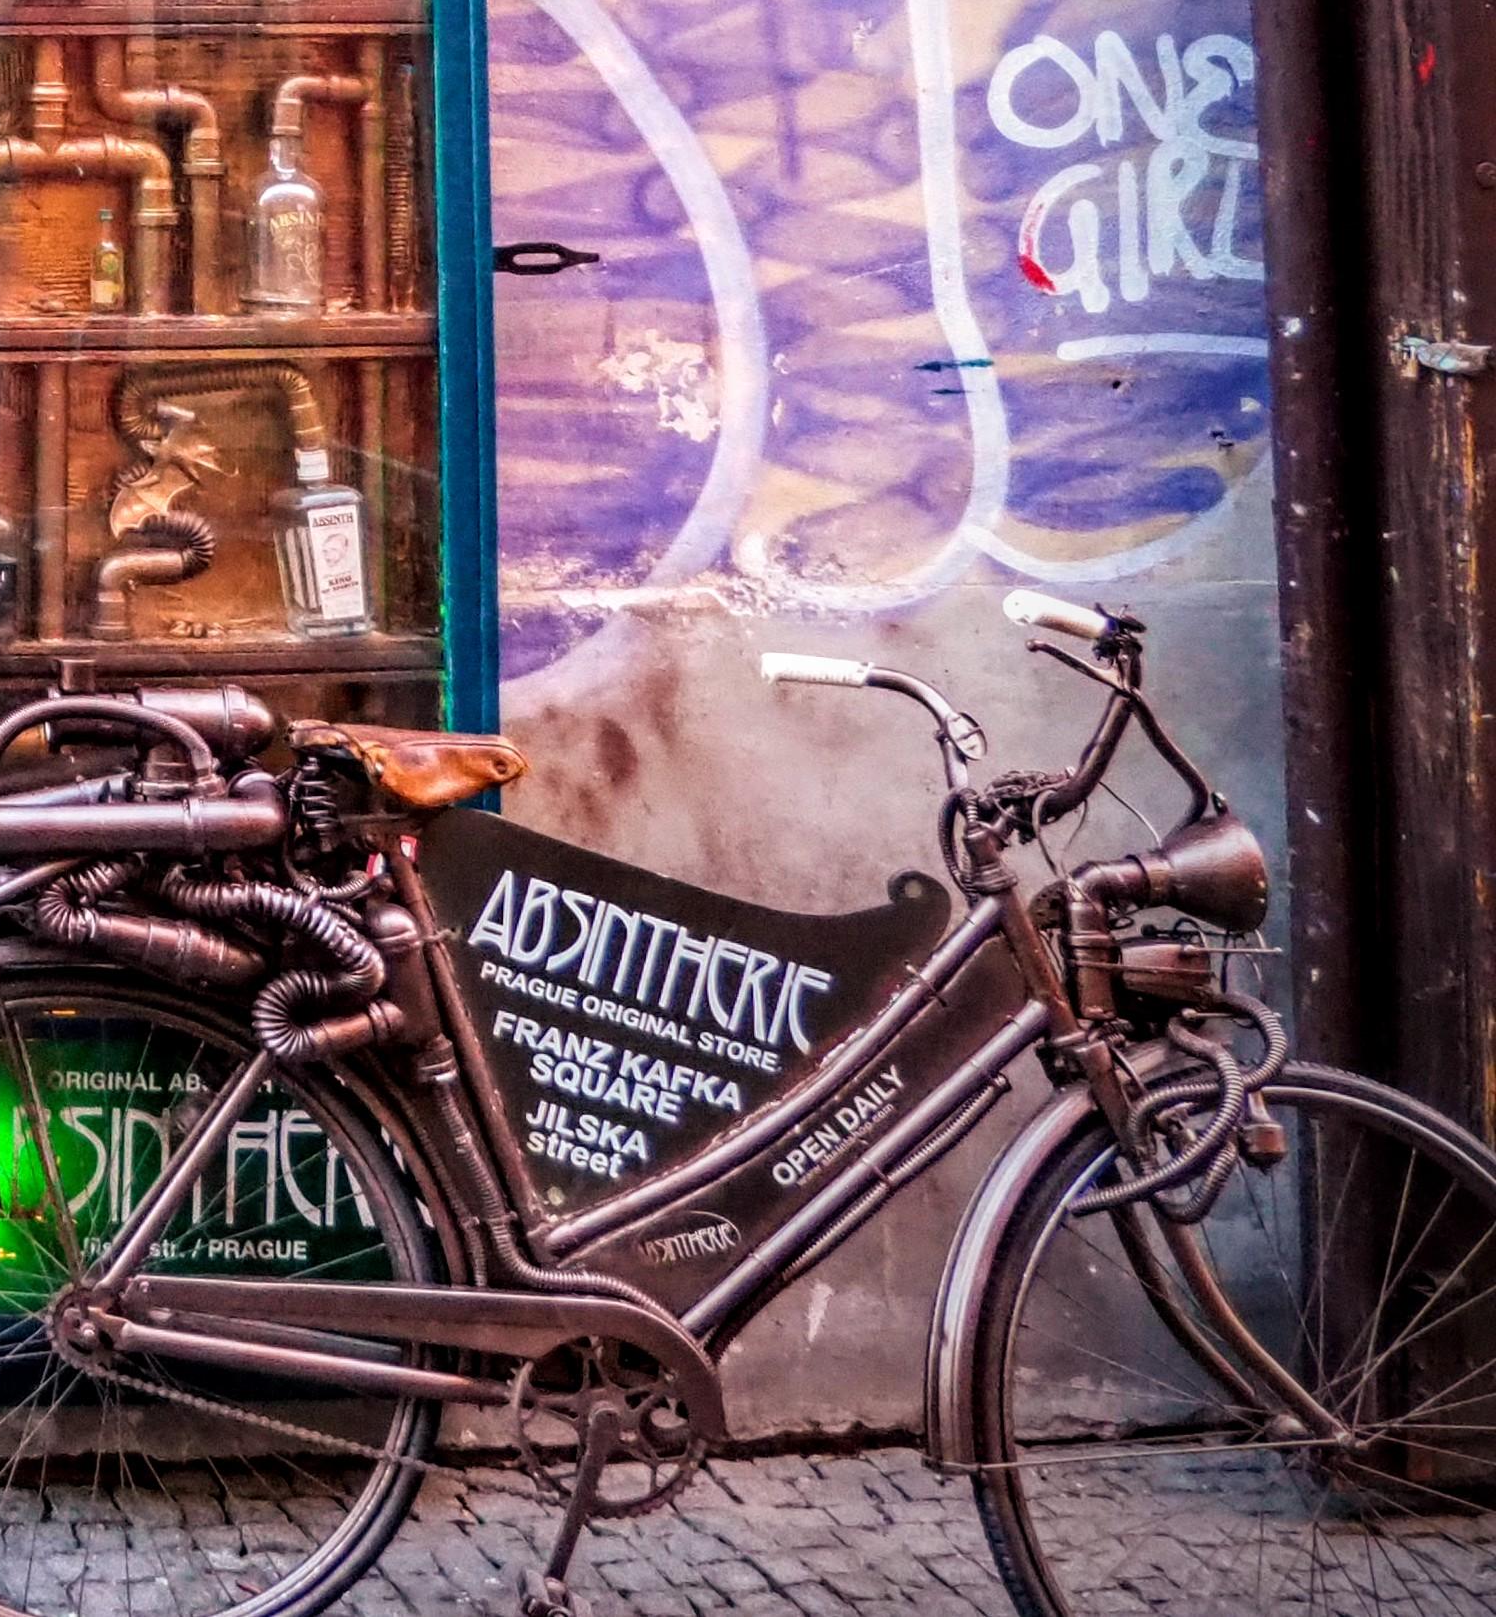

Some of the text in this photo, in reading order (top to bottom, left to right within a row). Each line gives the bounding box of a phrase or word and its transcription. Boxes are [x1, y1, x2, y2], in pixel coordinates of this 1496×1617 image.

[468, 869, 833, 1056] ABSINTHERIE
[479, 960, 578, 1010] PRAGUE
[582, 994, 692, 1046] ORIGINAL
[52, 1070, 162, 1092] ORIGINAL
[492, 1009, 743, 1112] FRANZ KAFKA
[529, 1052, 684, 1124] SQUARE
[525, 1099, 650, 1162] JILSKA
[526, 1130, 624, 1179] street
[771, 1064, 905, 1186] OPEN DAILY
[208, 1239, 308, 1259] PRAGUE
